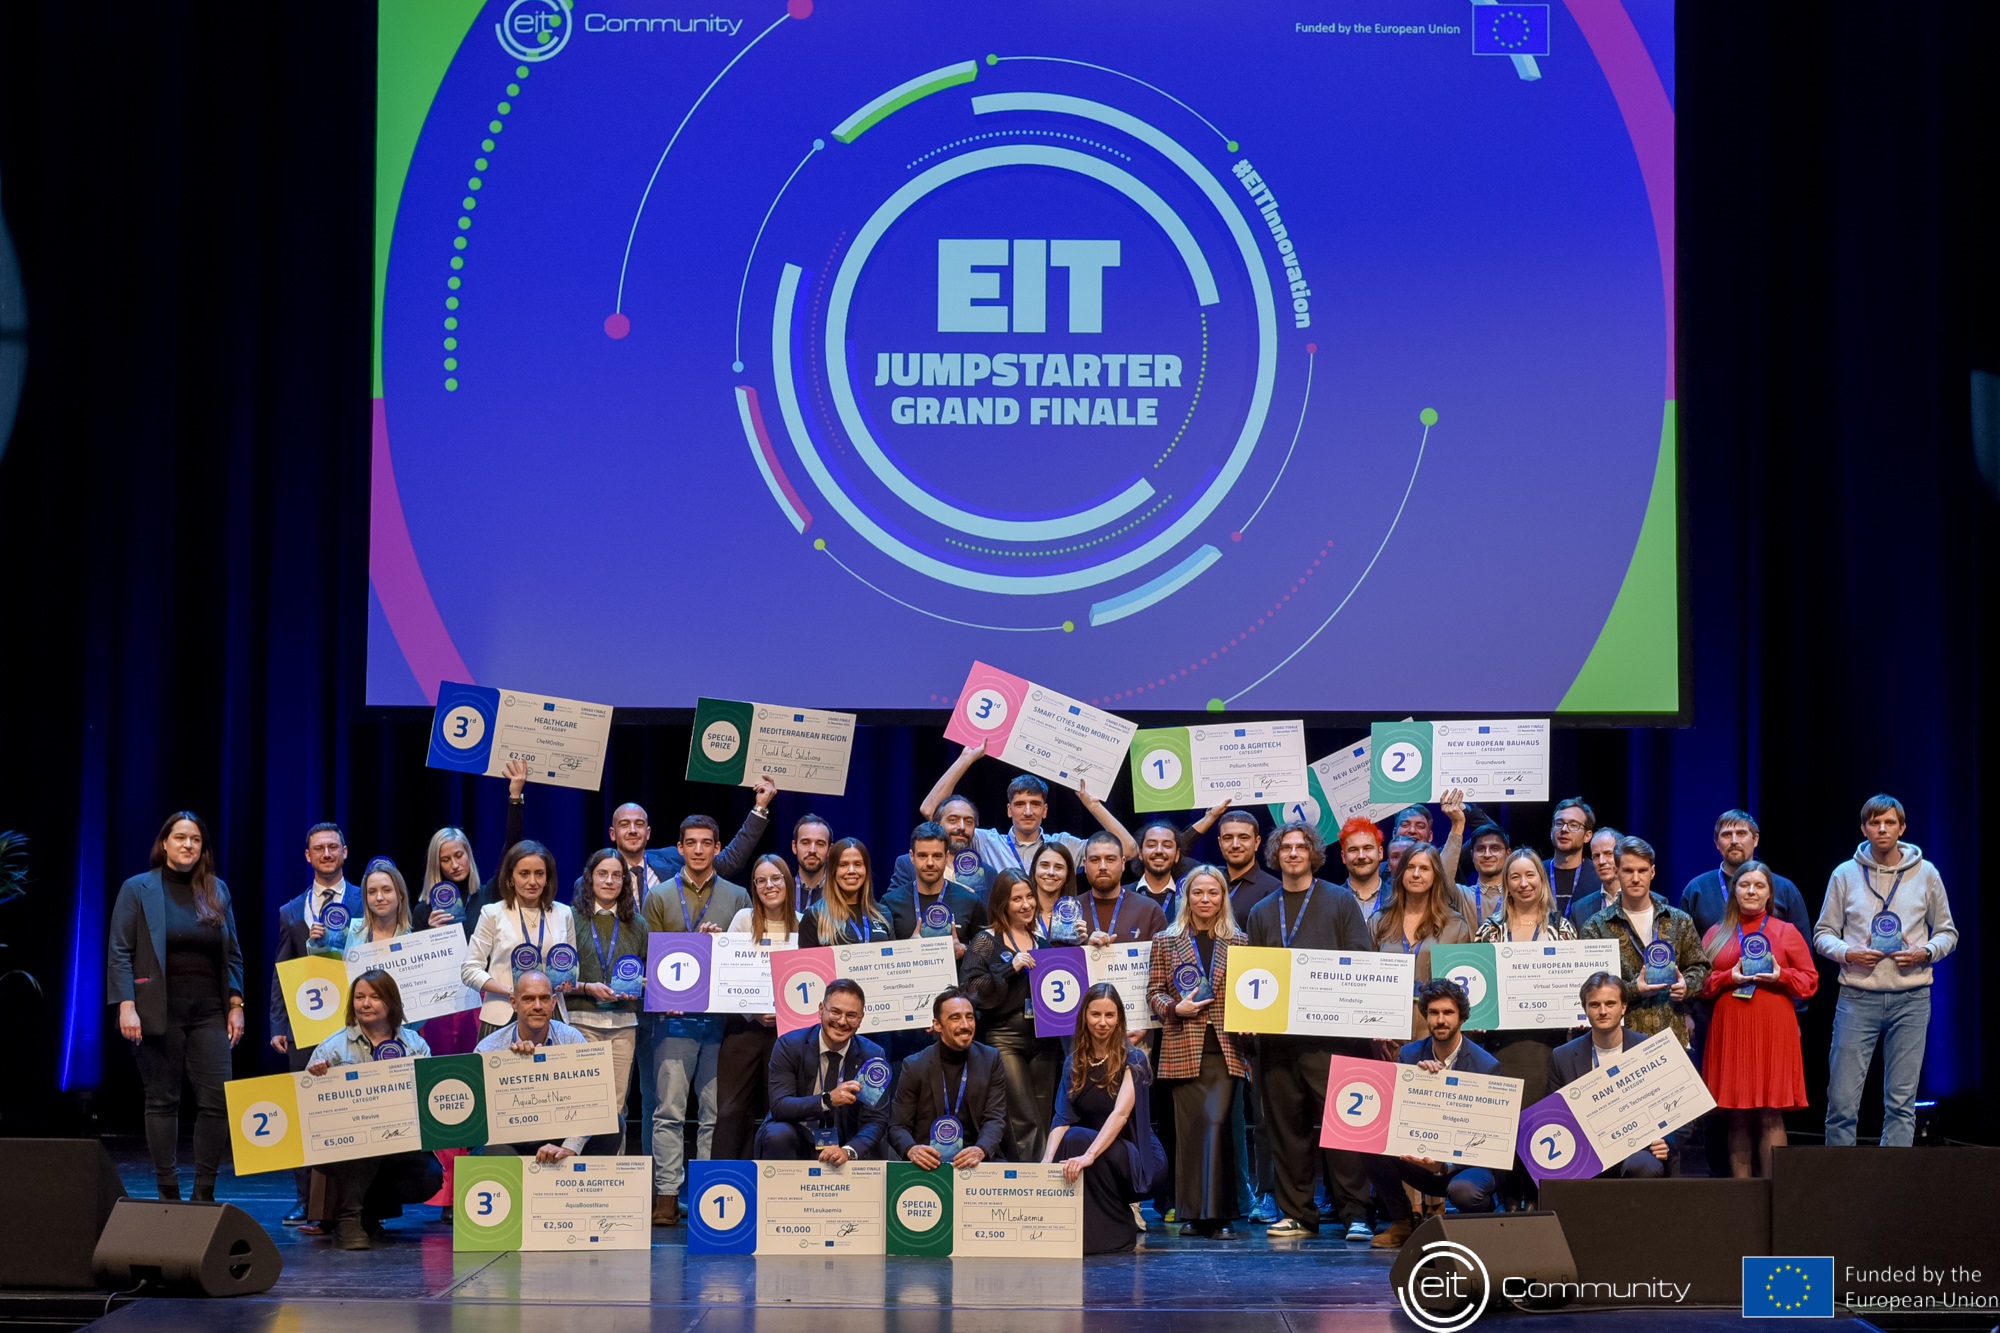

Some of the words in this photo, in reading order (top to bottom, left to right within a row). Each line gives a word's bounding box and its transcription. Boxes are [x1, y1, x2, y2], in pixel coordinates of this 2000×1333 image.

[514, 11, 553, 33] eit
[585, 13, 743, 36] Community
[1296, 23, 1335, 33] Funded
[1338, 23, 1351, 35] by
[1354, 23, 1371, 33] the
[1375, 23, 1425, 35] European
[1428, 24, 1460, 34] Union
[1232, 159, 1312, 329] #EITInnovation
[938, 239, 1121, 333] EIT
[875, 353, 1183, 387] JUMPSTARTER
[891, 397, 1020, 425] GRAND
[1030, 398, 1158, 426] FINALE
[975, 697, 1001, 719] 3rd
[453, 716, 476, 738] 3rd
[534, 717, 577, 728] HEALTHCARE
[1033, 706, 1056, 721] SMART
[1056, 715, 1076, 729] CITIES
[1076, 723, 1090, 733] AND
[1090, 728, 1121, 745] MOBILITY
[537, 738, 564, 747] CheMOnitor
[707, 733, 736, 742] SPECIAL
[759, 727, 819, 740] MEDITERRANEAN
[821, 734, 848, 742] REGION
[1064, 727, 1087, 739] CATEGORY
[1025, 743, 1051, 758] €2,500
[1054, 736, 1082, 752] SignalWings
[510, 752, 536, 761] €2,500
[1392, 751, 1415, 772] 2nd
[1152, 758, 1171, 779] 1st
[1333, 771, 1348, 781] NEW
[1349, 759, 1371, 774] EUROP
[1210, 780, 1241, 789] €10,000
[410, 948, 454, 963] UKRAINE
[399, 964, 424, 972] CATEGORY
[670, 962, 689, 981] 1st
[1108, 964, 1127, 972] RAW
[1310, 971, 1352, 980] REBUILD
[1356, 974, 1399, 983] UKRAINE
[306, 985, 328, 1011] 3rd
[796, 982, 815, 1004] 1st
[1051, 980, 1070, 1002] 3rd
[1248, 979, 1268, 999] 1st
[1306, 1013, 1339, 1021] €10,000
[499, 1073, 549, 1085] WESTERN
[553, 1068, 600, 1079] BALKANS
[1592, 1086, 1614, 1103] RAW
[1615, 1055, 1668, 1089] MATERIALS
[1622, 1078, 1645, 1094] CATEGORY
[318, 1088, 361, 1102] REBUILD
[366, 1081, 412, 1096] UKRAINE
[433, 1093, 470, 1102] SPECIAL
[1408, 1088, 1433, 1096] SMART
[1434, 1091, 1456, 1099] CITIES
[1475, 1096, 1510, 1106] MOBILITY
[1628, 1086, 1661, 1109] Technologies
[440, 1102, 465, 1110] PRIZE
[1347, 1092, 1373, 1116] 2nd
[253, 1110, 277, 1137] 2nd
[509, 1115, 538, 1124] €5,000
[1409, 1130, 1439, 1140] €5,000
[1610, 1121, 1638, 1140] €5,000
[324, 1136, 355, 1147] €5,000
[1539, 1131, 1562, 1161] 2nd
[477, 1192, 500, 1215] 3rd
[713, 1196, 733, 1218] 1st
